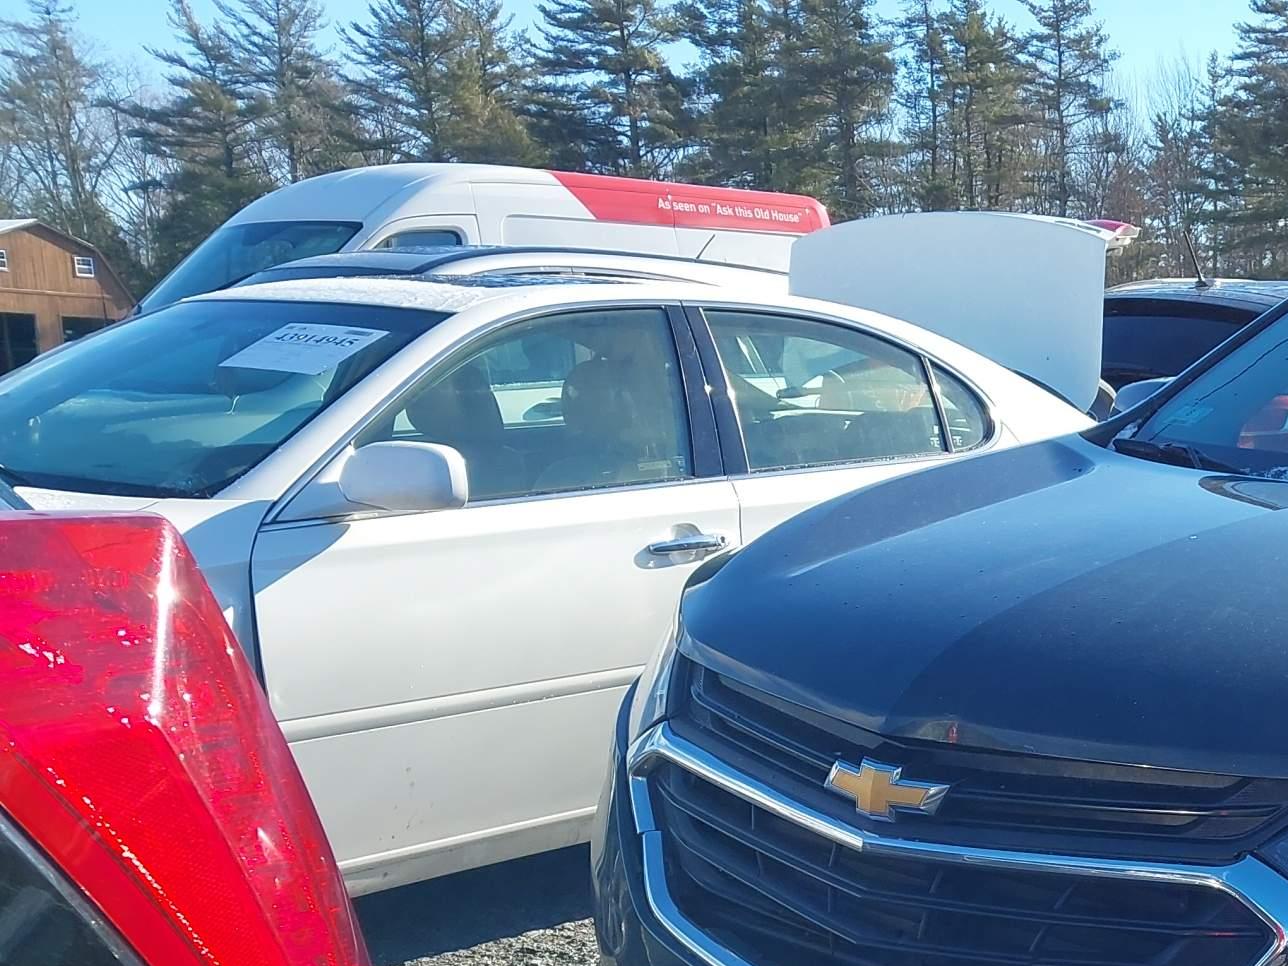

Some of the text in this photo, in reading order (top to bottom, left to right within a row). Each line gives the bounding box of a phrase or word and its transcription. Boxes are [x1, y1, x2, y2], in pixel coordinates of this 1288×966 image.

[658, 197, 670, 210] As
[672, 199, 696, 213] seen
[698, 205, 710, 214] on
[735, 206, 752, 218] this
[754, 208, 770, 220] Old
